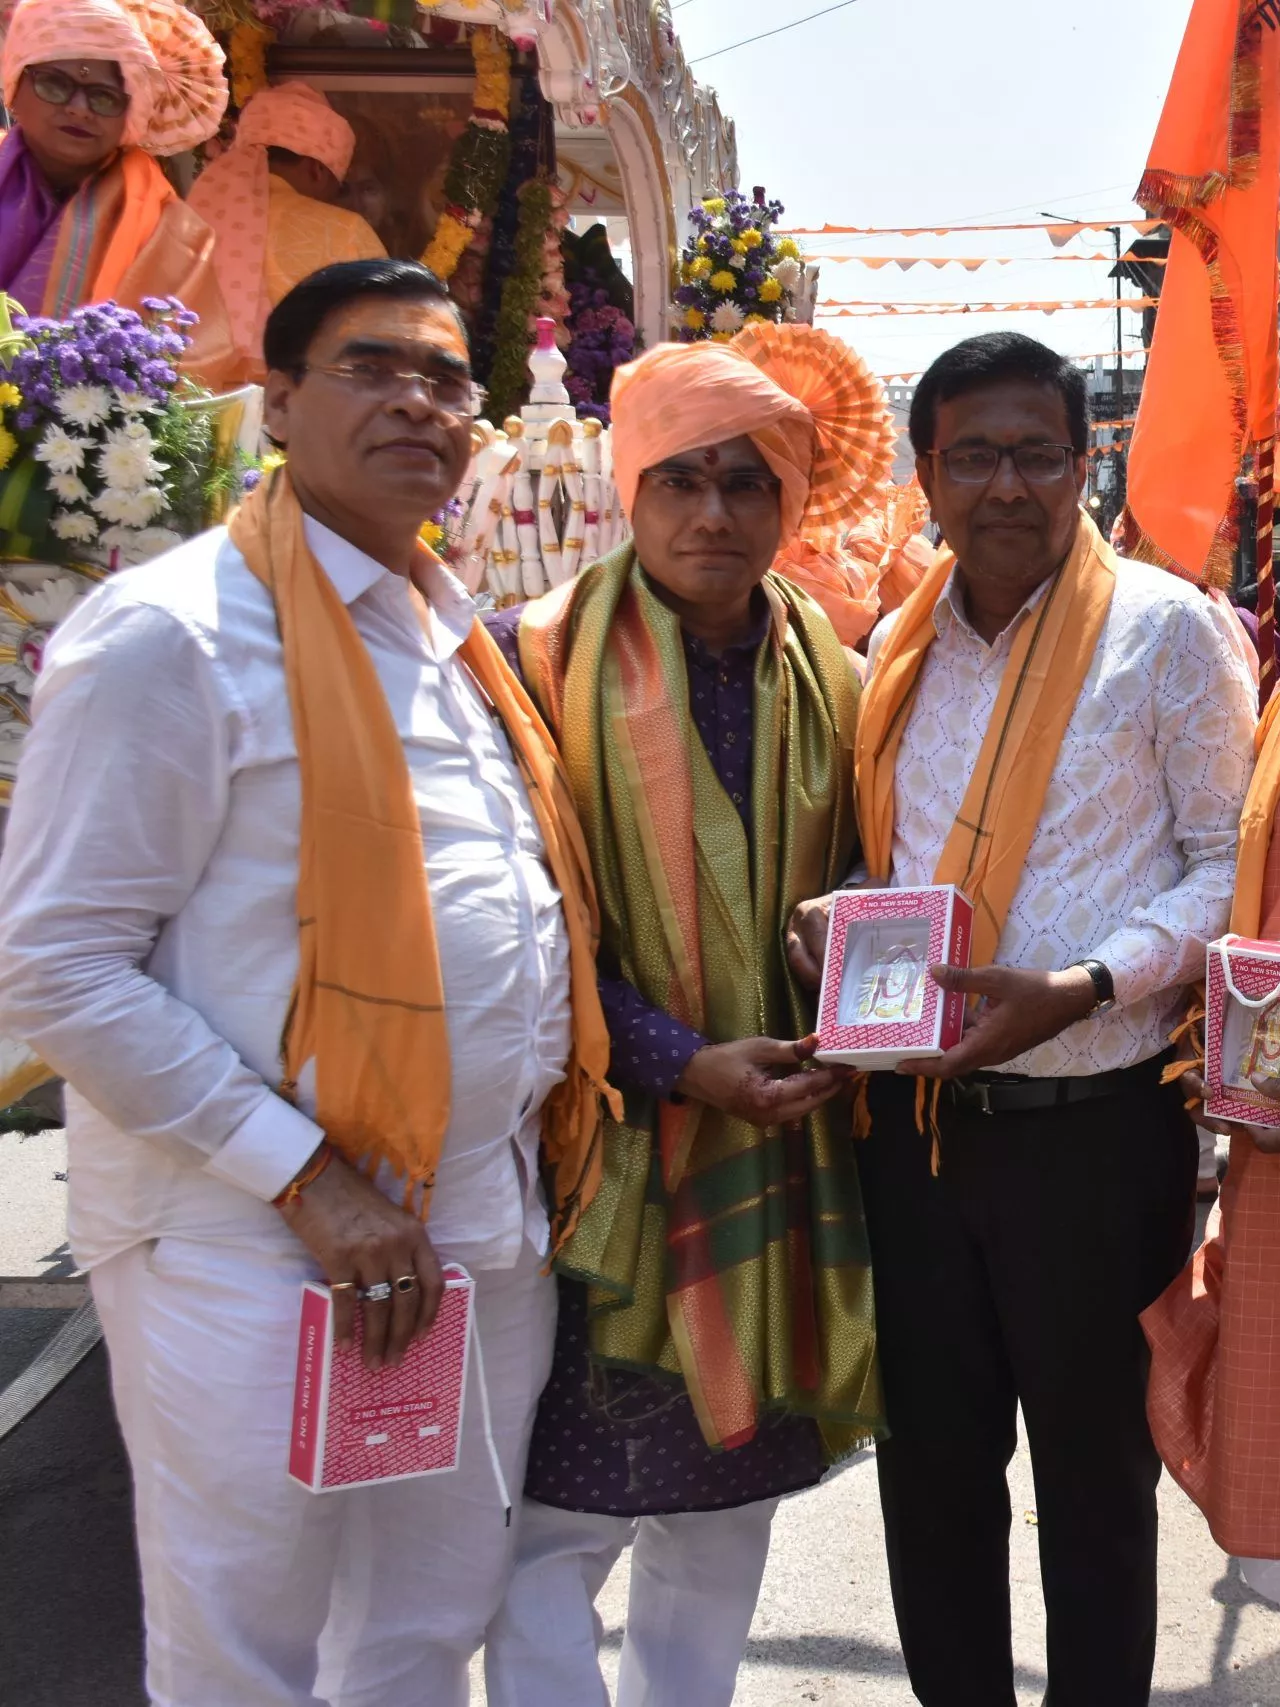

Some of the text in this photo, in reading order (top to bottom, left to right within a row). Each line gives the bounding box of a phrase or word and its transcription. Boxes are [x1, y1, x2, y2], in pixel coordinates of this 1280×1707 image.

[954, 925, 963, 965] STAND
[949, 1020, 954, 1029] 2
[305, 1325, 316, 1373] STAND
[302, 1376, 311, 1409] NEW
[355, 1401, 433, 1420] 2 NO. NEW STAND
[299, 1414, 308, 1437] NO.
